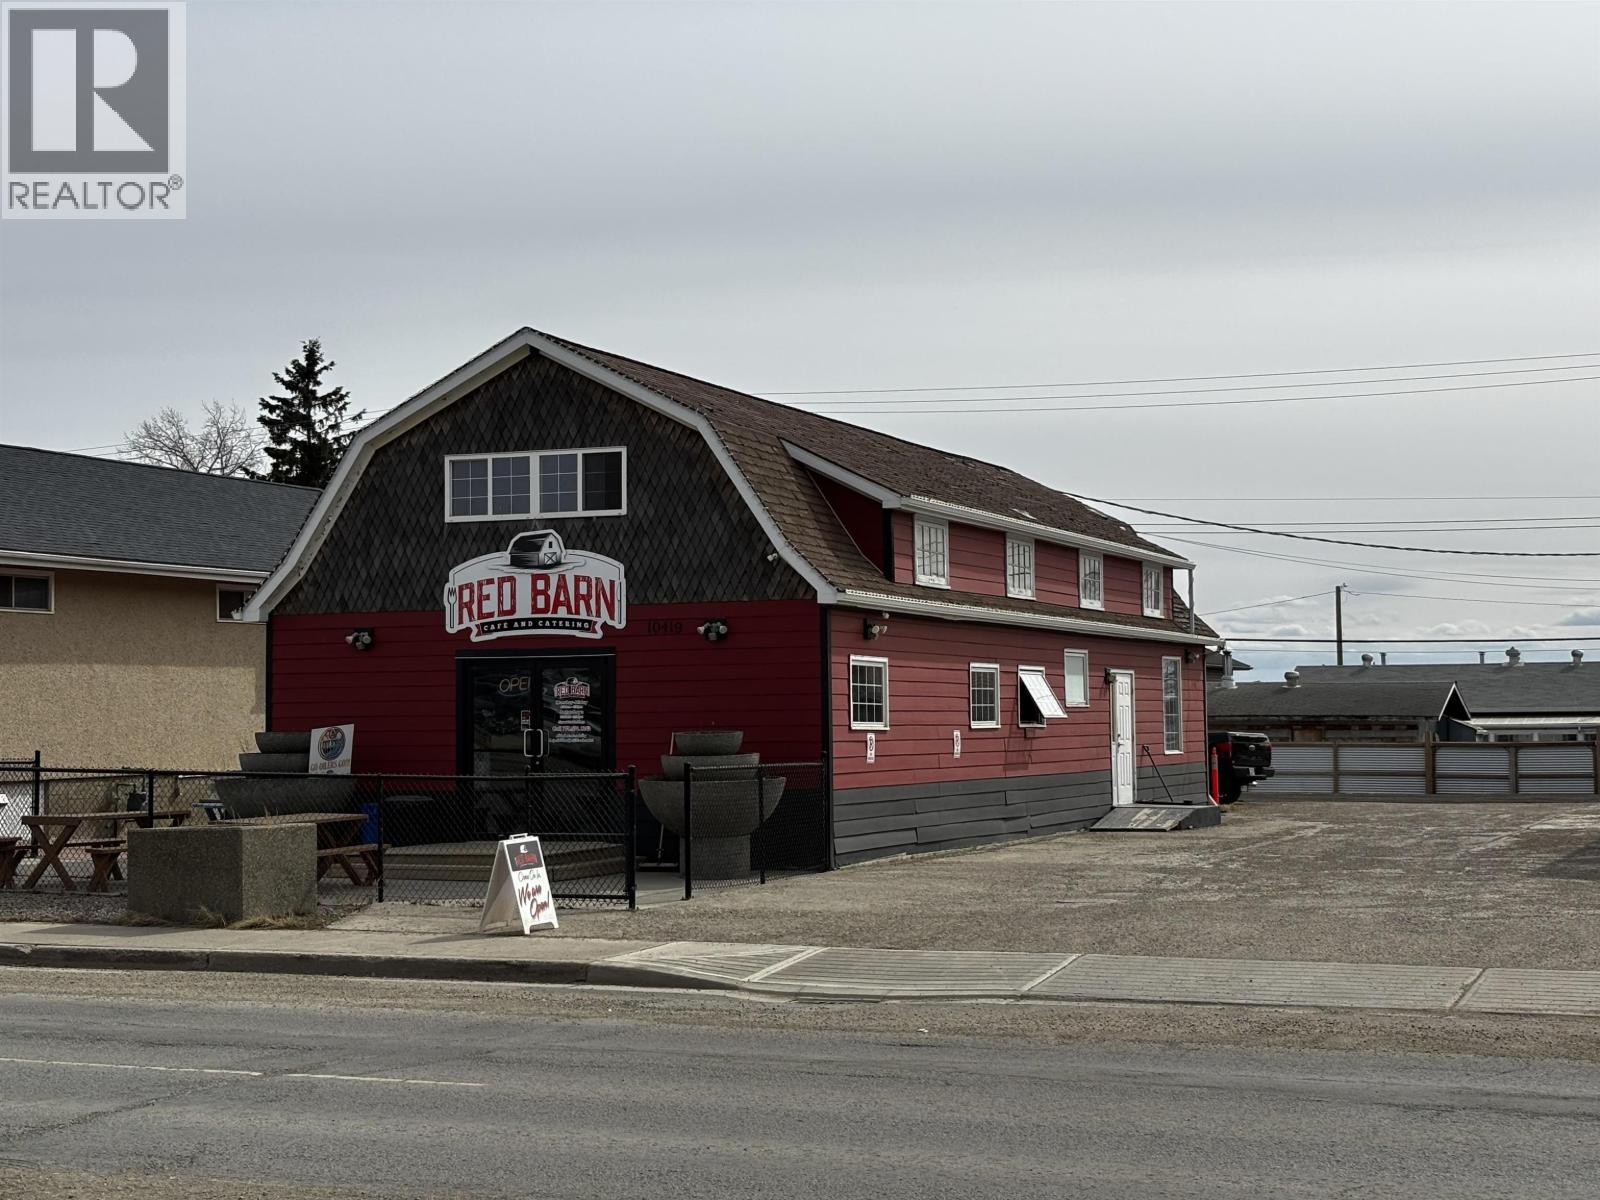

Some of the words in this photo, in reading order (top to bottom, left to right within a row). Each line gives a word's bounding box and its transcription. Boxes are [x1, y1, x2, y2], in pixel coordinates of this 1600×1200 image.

[458, 575, 516, 625] RED
[531, 573, 616, 621] BARN
[513, 620, 533, 628] AND
[538, 620, 590, 629] CATERING
[518, 882, 532, 908] We
[532, 884, 542, 897] are
